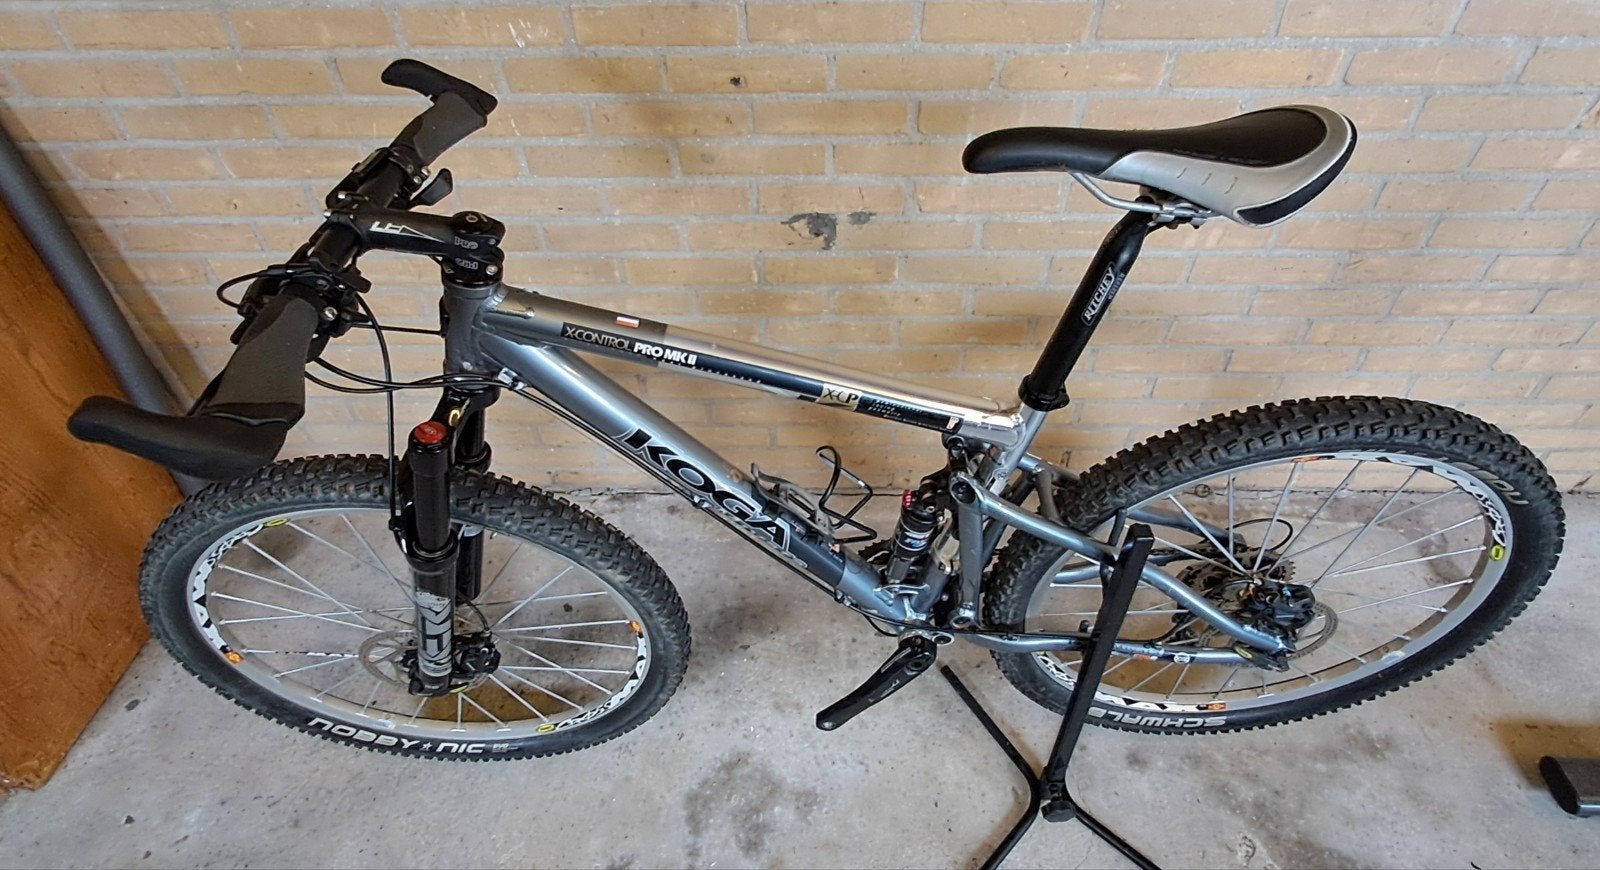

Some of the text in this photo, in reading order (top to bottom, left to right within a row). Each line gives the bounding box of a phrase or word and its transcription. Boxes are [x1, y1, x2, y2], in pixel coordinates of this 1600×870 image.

[1084, 266, 1115, 321] RITCHEY
[633, 342, 663, 358] PRO
[622, 427, 789, 551] KOGA
[307, 717, 420, 749] NOBBY
[435, 742, 486, 754] NIC
[1086, 706, 1228, 729] SCHWALB
